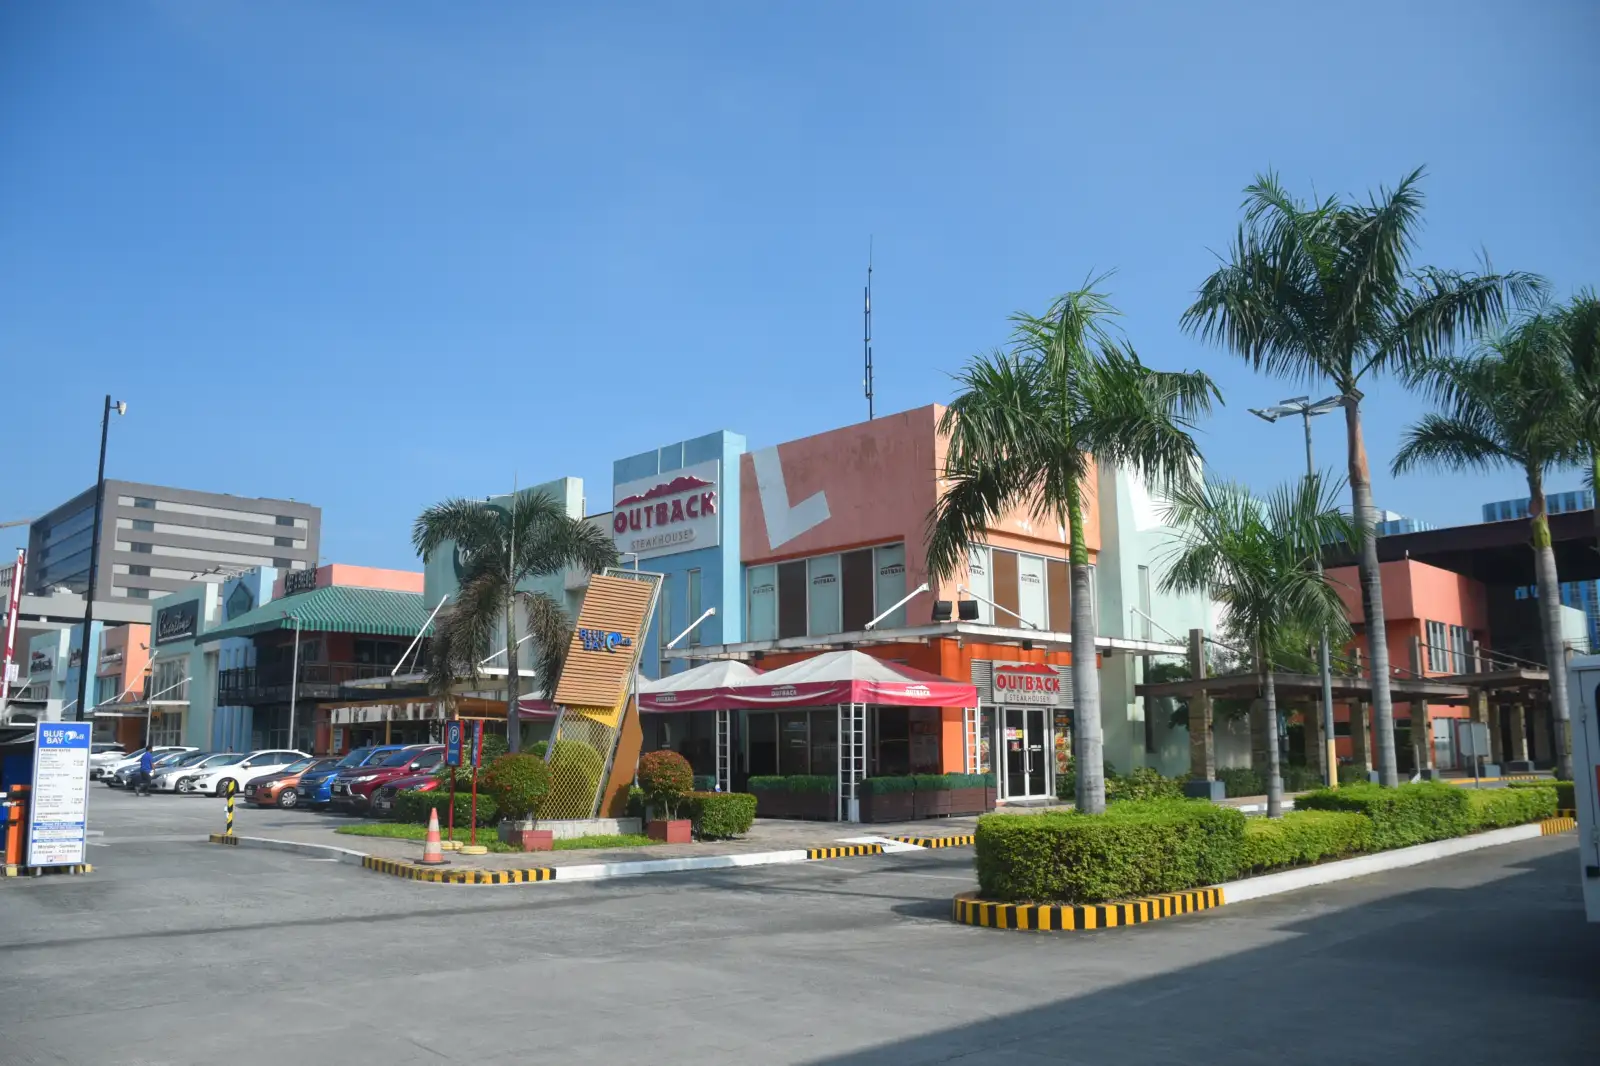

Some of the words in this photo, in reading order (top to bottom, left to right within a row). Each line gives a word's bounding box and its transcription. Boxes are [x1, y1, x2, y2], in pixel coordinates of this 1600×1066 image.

[614, 491, 716, 533] OUTBACK
[813, 577, 837, 585] OUTBACK
[583, 640, 605, 651] BAY
[996, 674, 1061, 692] OUTBACK
[770, 689, 797, 697] OUTBACK
[452, 729, 458, 741] P
